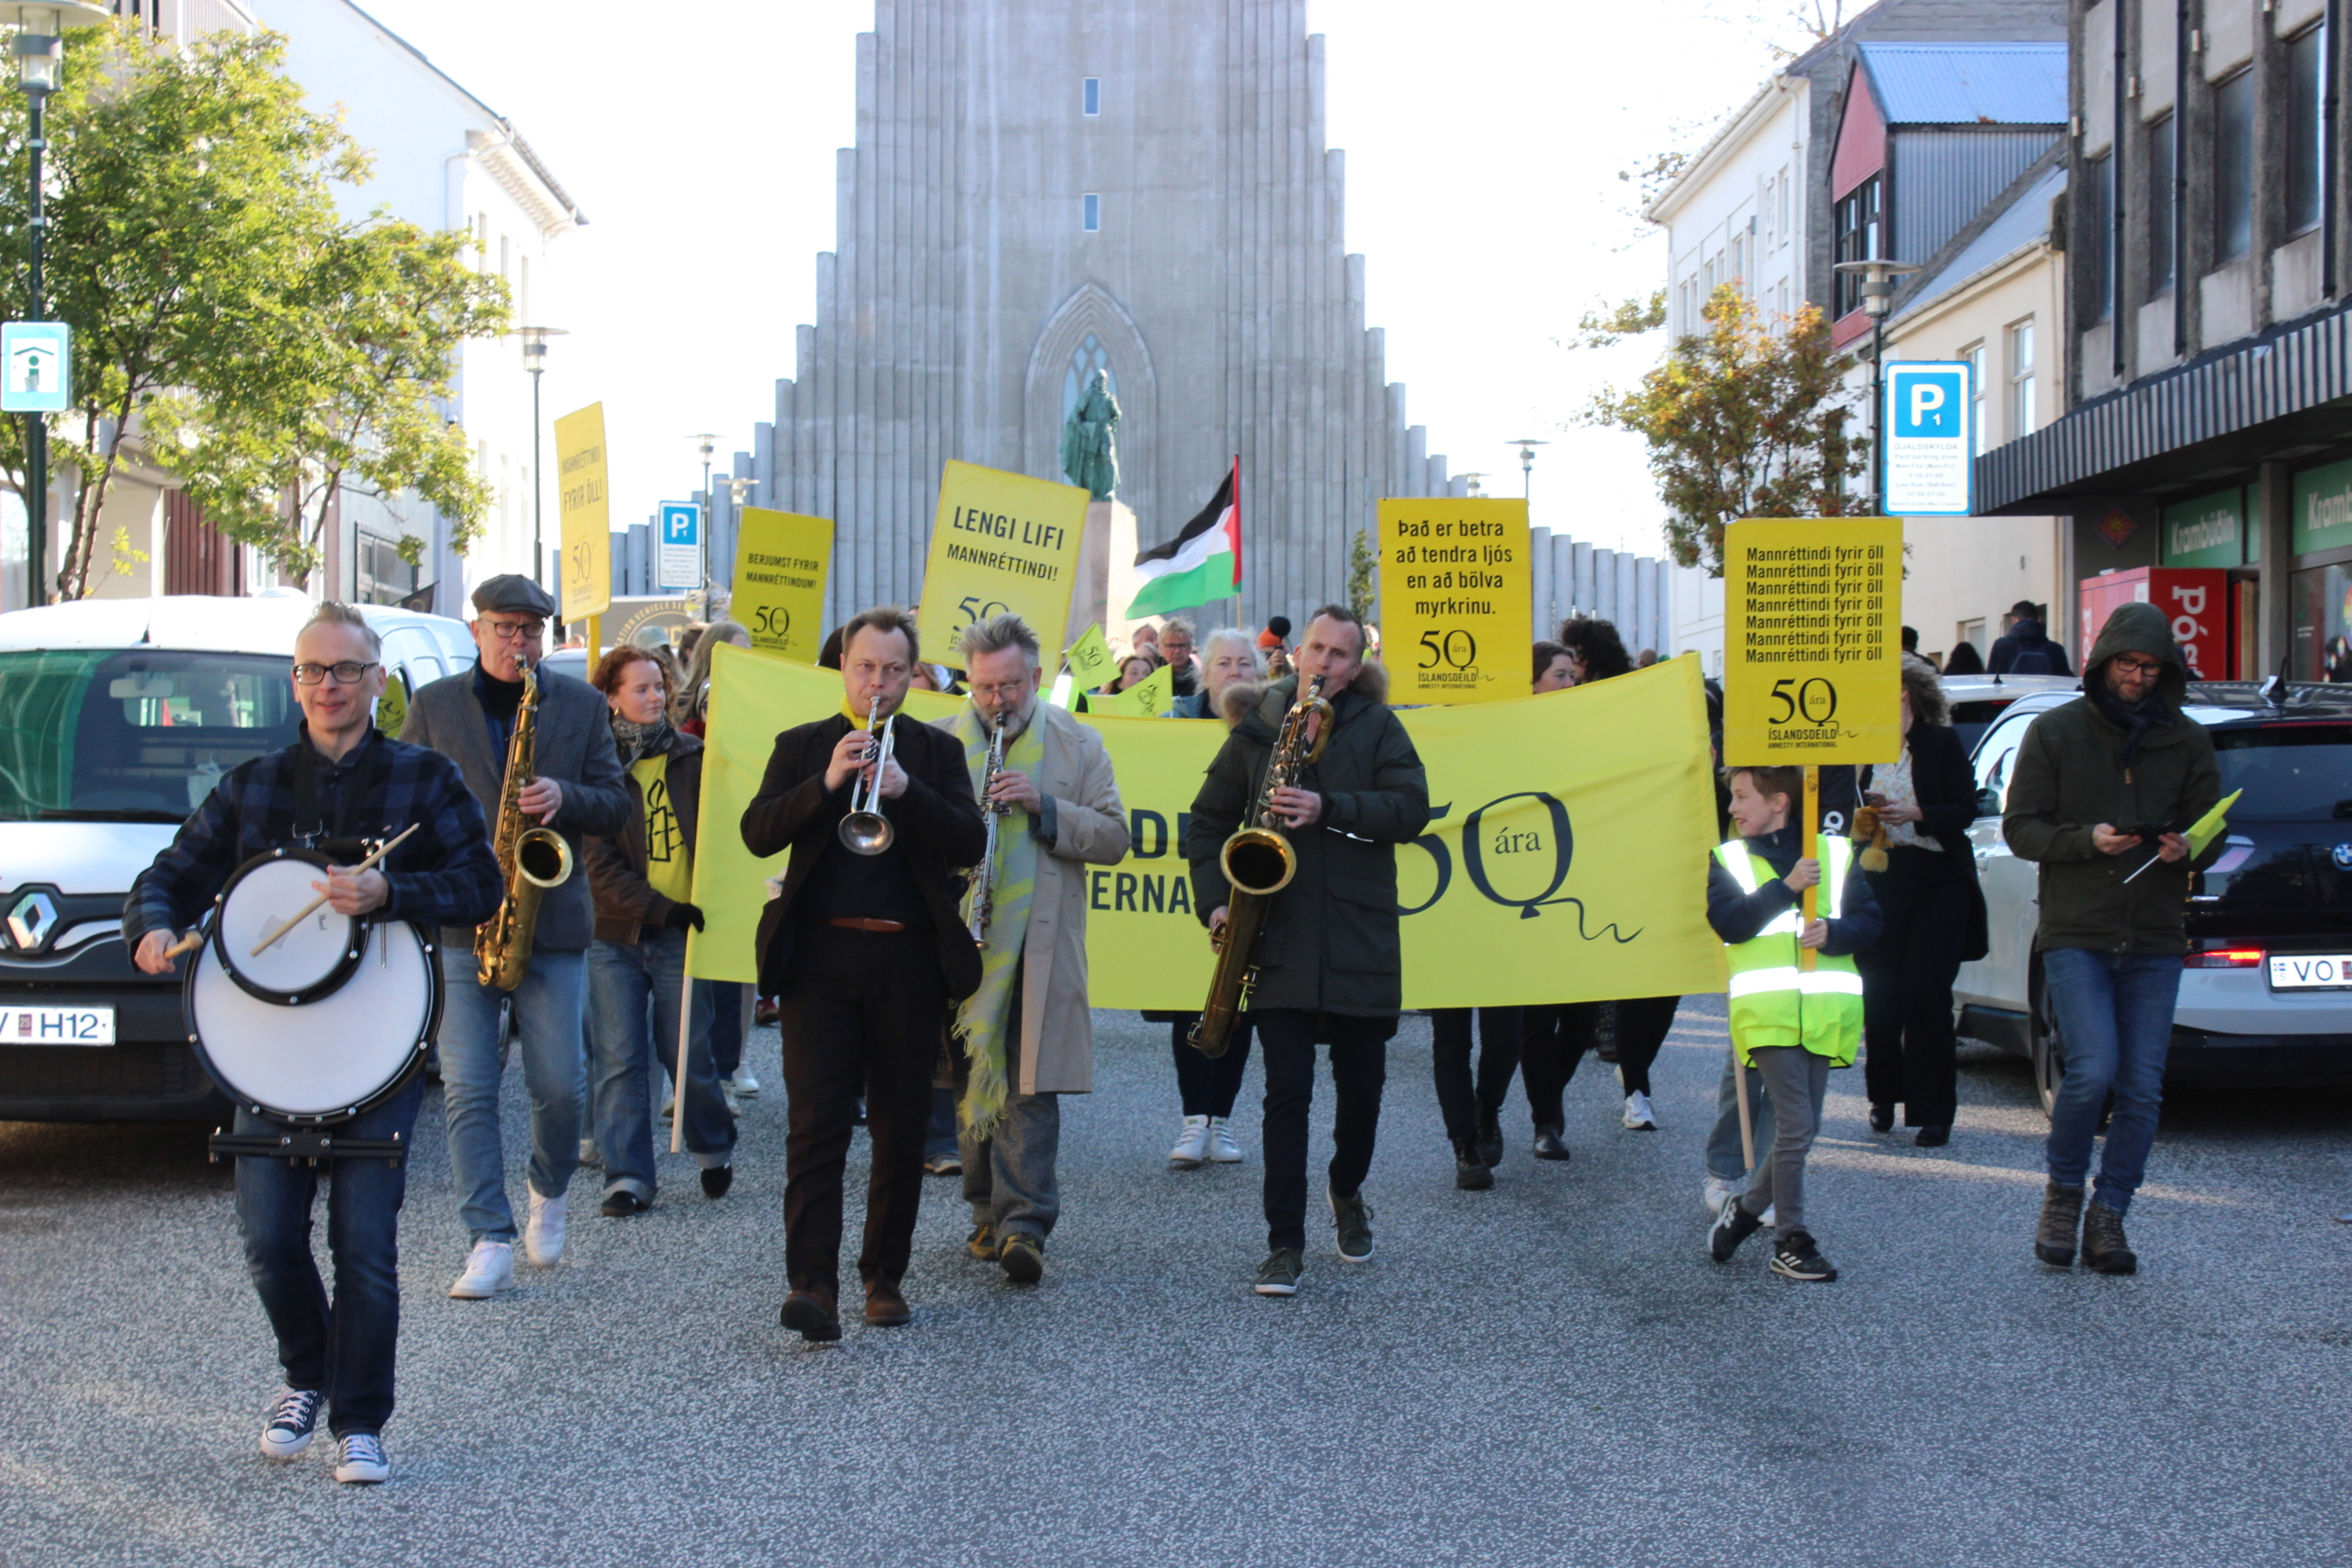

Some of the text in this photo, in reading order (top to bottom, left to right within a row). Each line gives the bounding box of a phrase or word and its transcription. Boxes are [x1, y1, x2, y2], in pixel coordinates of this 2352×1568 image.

[1911, 384, 1945, 427] P
[1912, 453, 1939, 461] parking
[563, 485, 585, 514] FYRIR
[672, 513, 690, 539] P
[953, 505, 1065, 551] LENGI LIFI
[1398, 519, 1504, 537] Það er betra
[2171, 509, 2235, 556] Krambúðin
[572, 541, 592, 585] 50
[748, 553, 820, 571] BERJUMST FYRIR
[946, 543, 1058, 582] MANNRÉTTINDI!
[1396, 544, 1513, 566] að tendra ljós
[1747, 546, 1883, 562] Mannréttindi fyrir öll
[745, 571, 818, 590] MANNRÉTTINDUM!
[1407, 571, 1504, 589] en að bölva
[1747, 562, 1883, 580] Mannréttindi fyrir öll
[1747, 580, 1883, 596] Mannréttindi fyrir öll
[634, 602, 669, 621] VEHICLE
[1415, 597, 1497, 618] myrkrinu.
[1747, 596, 1883, 614] Mannréttindi fyrir öll
[752, 605, 790, 635] 50
[1747, 613, 1883, 630] Mannréttindi fyrir öll
[1747, 630, 1883, 647] Mannréttindi fyrir öll
[1418, 629, 1476, 669] 50
[1452, 644, 1467, 653] ára
[1746, 647, 1882, 664] Mannréttindi fyrir öll
[1418, 671, 1477, 682] ÍSLANDSDEILD
[1768, 677, 1838, 725] 50
[1809, 694, 1826, 705] ára
[1768, 728, 1837, 741] ÍSLANDSDEILD
[1768, 741, 1793, 750] AMNESTY
[1495, 826, 1543, 855] ára
[1086, 870, 1192, 915] ERNA
[2293, 960, 2334, 982] VO
[40, 1012, 98, 1039] H12
